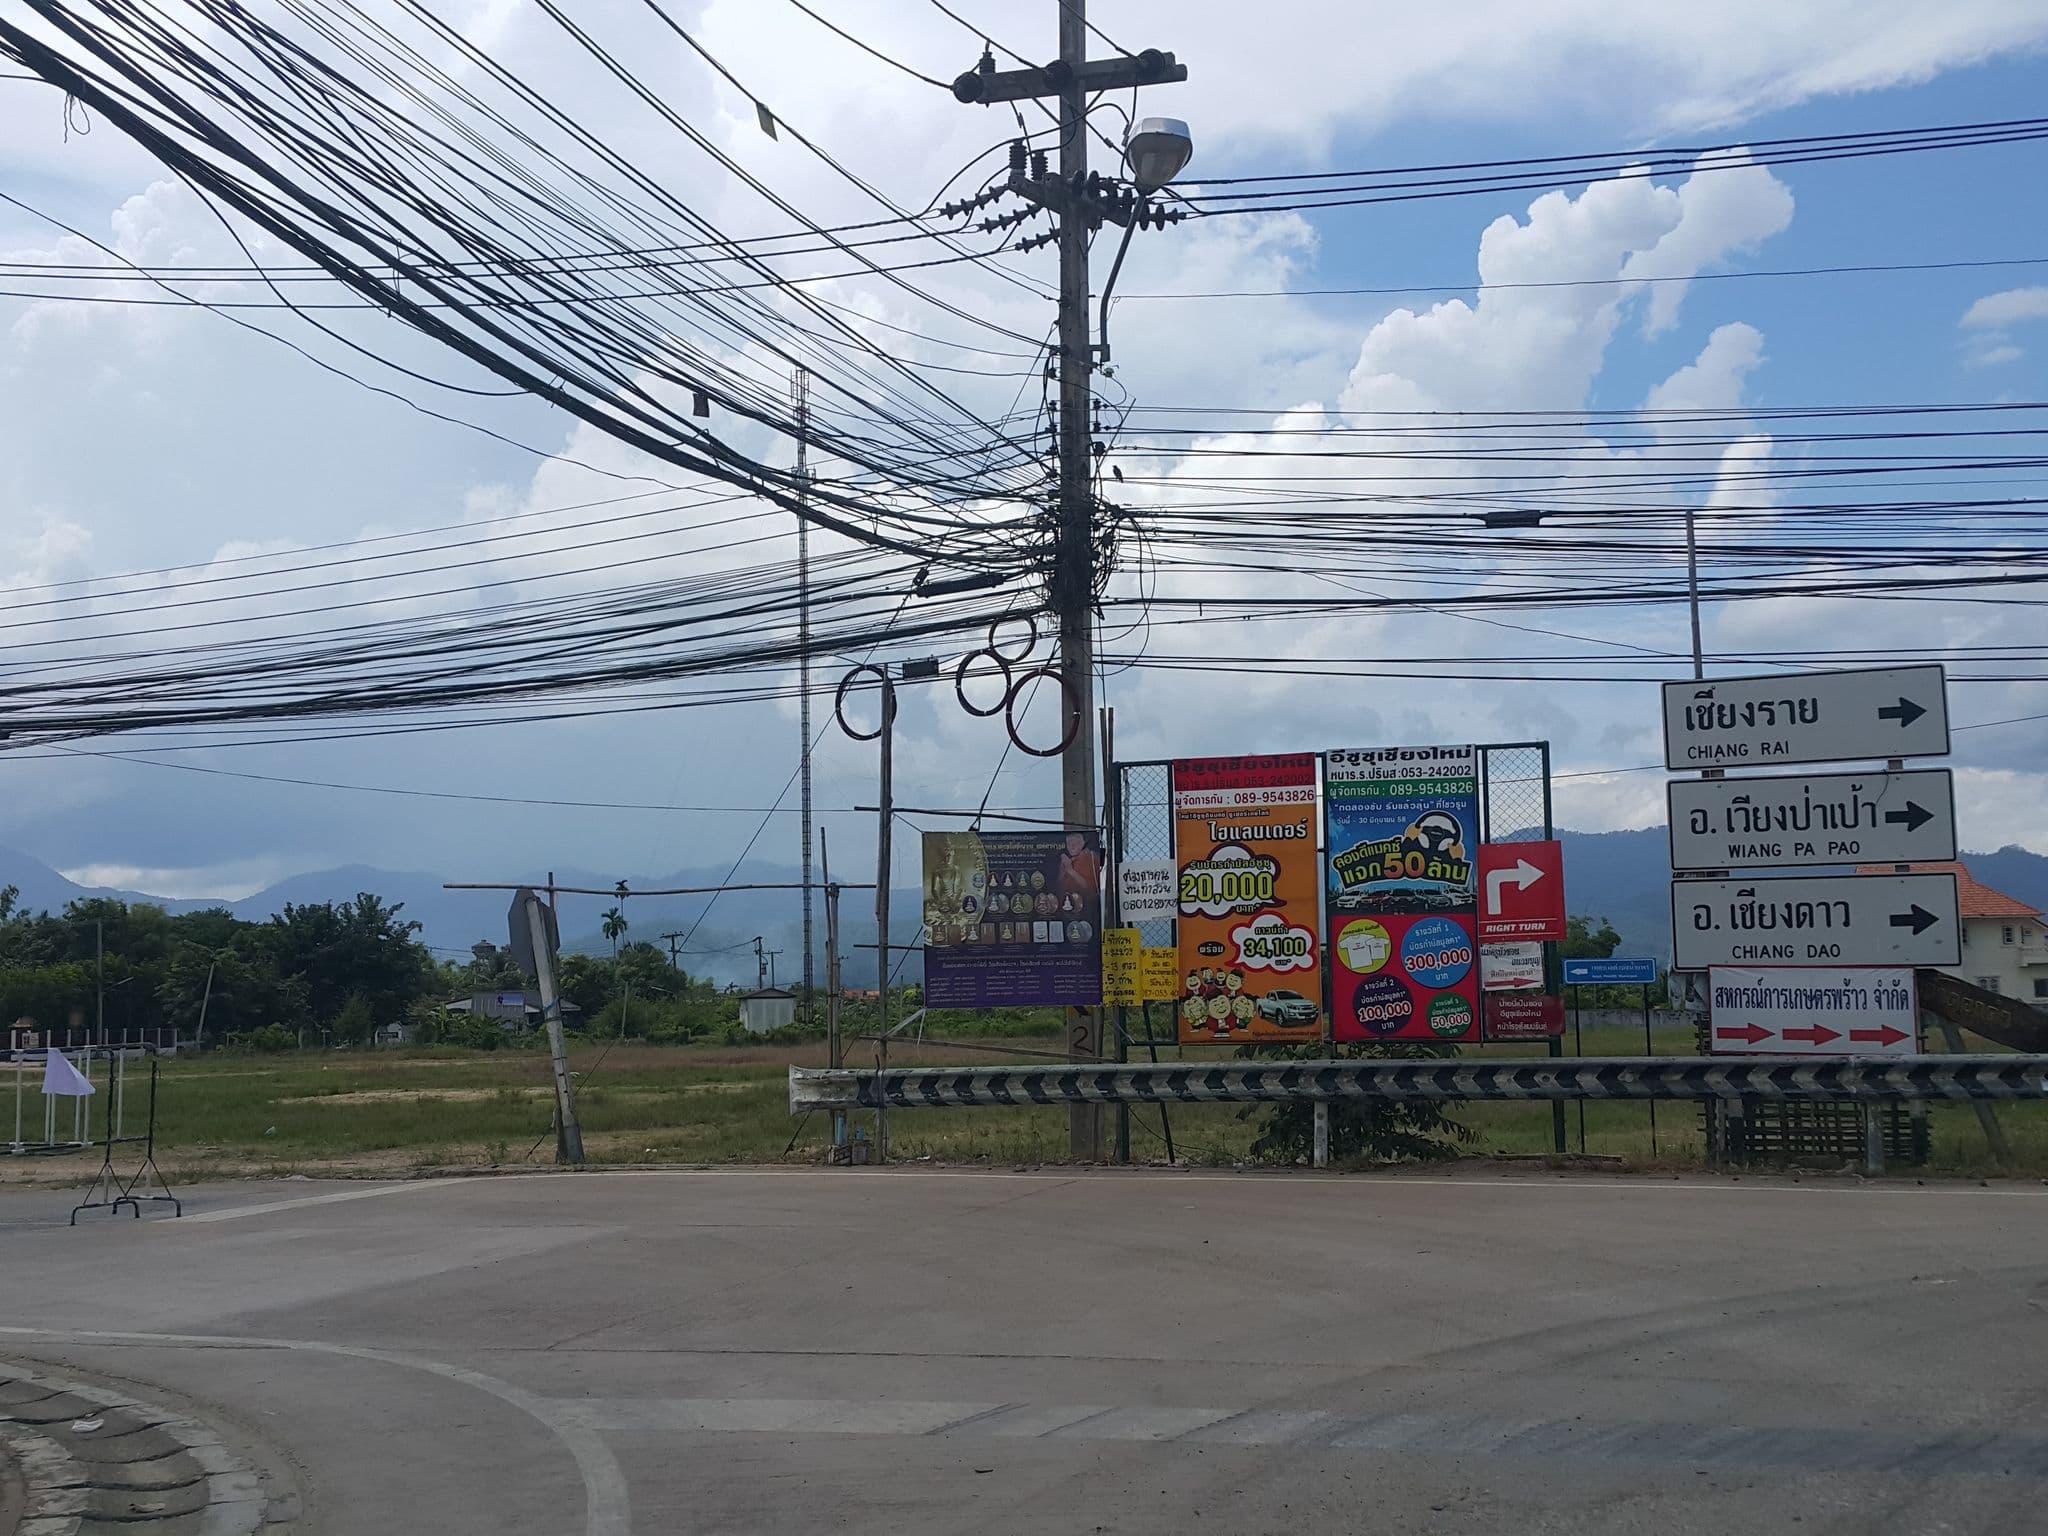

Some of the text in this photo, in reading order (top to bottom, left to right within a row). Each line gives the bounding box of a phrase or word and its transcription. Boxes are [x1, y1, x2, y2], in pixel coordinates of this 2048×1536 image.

[1685, 689, 1819, 731] เชียงราย
[1687, 741, 1789, 760] CHIANG RAI
[1234, 790, 1314, 804] 089-9543826
[1390, 782, 1473, 796] 089-9543826
[1690, 785, 1877, 834] อ. เวียงป่าเป้า
[1208, 818, 1308, 841] ไฮแลนเดอร์
[1728, 841, 1860, 859] WIANG PA PAO
[1344, 851, 1468, 884] แจก 50 ล้าน
[1180, 871, 1274, 905] 20,000
[1694, 888, 1850, 930] อ. เชียงดาว
[1486, 922, 1546, 933] RIGHT TURN
[1244, 937, 1306, 958] 34,100
[1732, 944, 1841, 959] CHIANG DAO
[1405, 947, 1470, 972] 300,000
[1715, 977, 1910, 1010] สหกรณ์การเกษตรพร้าว จำกัด
[1358, 1002, 1412, 1022] 100,000
[1432, 1014, 1470, 1029] 50,000
[1073, 1026, 1092, 1053] 2
